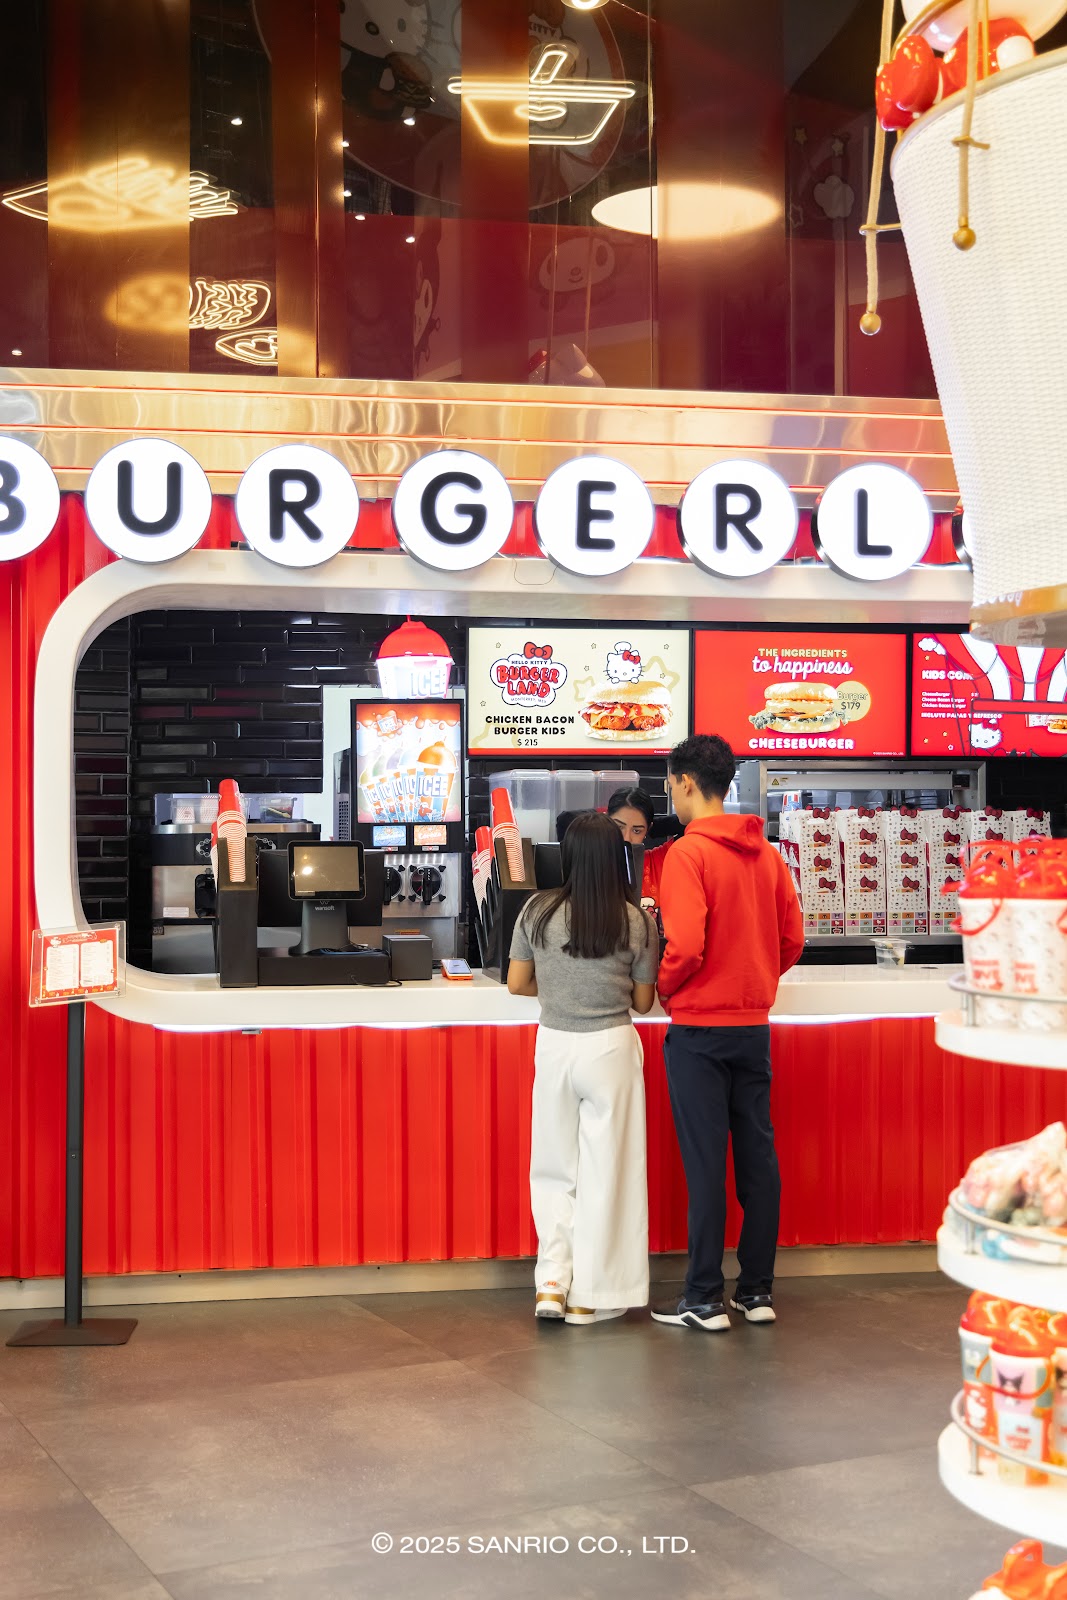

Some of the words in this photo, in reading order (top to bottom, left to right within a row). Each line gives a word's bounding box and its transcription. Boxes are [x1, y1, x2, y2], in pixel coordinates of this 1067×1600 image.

[758, 648, 778, 657] THE
[781, 648, 847, 658] INGREDIENTS
[752, 656, 772, 673] to
[773, 656, 853, 680] happiness
[496, 665, 560, 684] BURGER
[921, 670, 946, 679] KIDS
[507, 681, 551, 698] LAND
[837, 690, 868, 702] Burger
[841, 701, 861, 711] $179
[485, 715, 532, 724] CHICKEN
[536, 715, 575, 724] BACON
[494, 726, 538, 735] BURGER
[541, 726, 566, 735] KIDS
[517, 738, 523, 747] $
[524, 738, 538, 747] 215
[748, 737, 855, 750] CHEESEBURGER
[418, 775, 448, 797] ICEE
